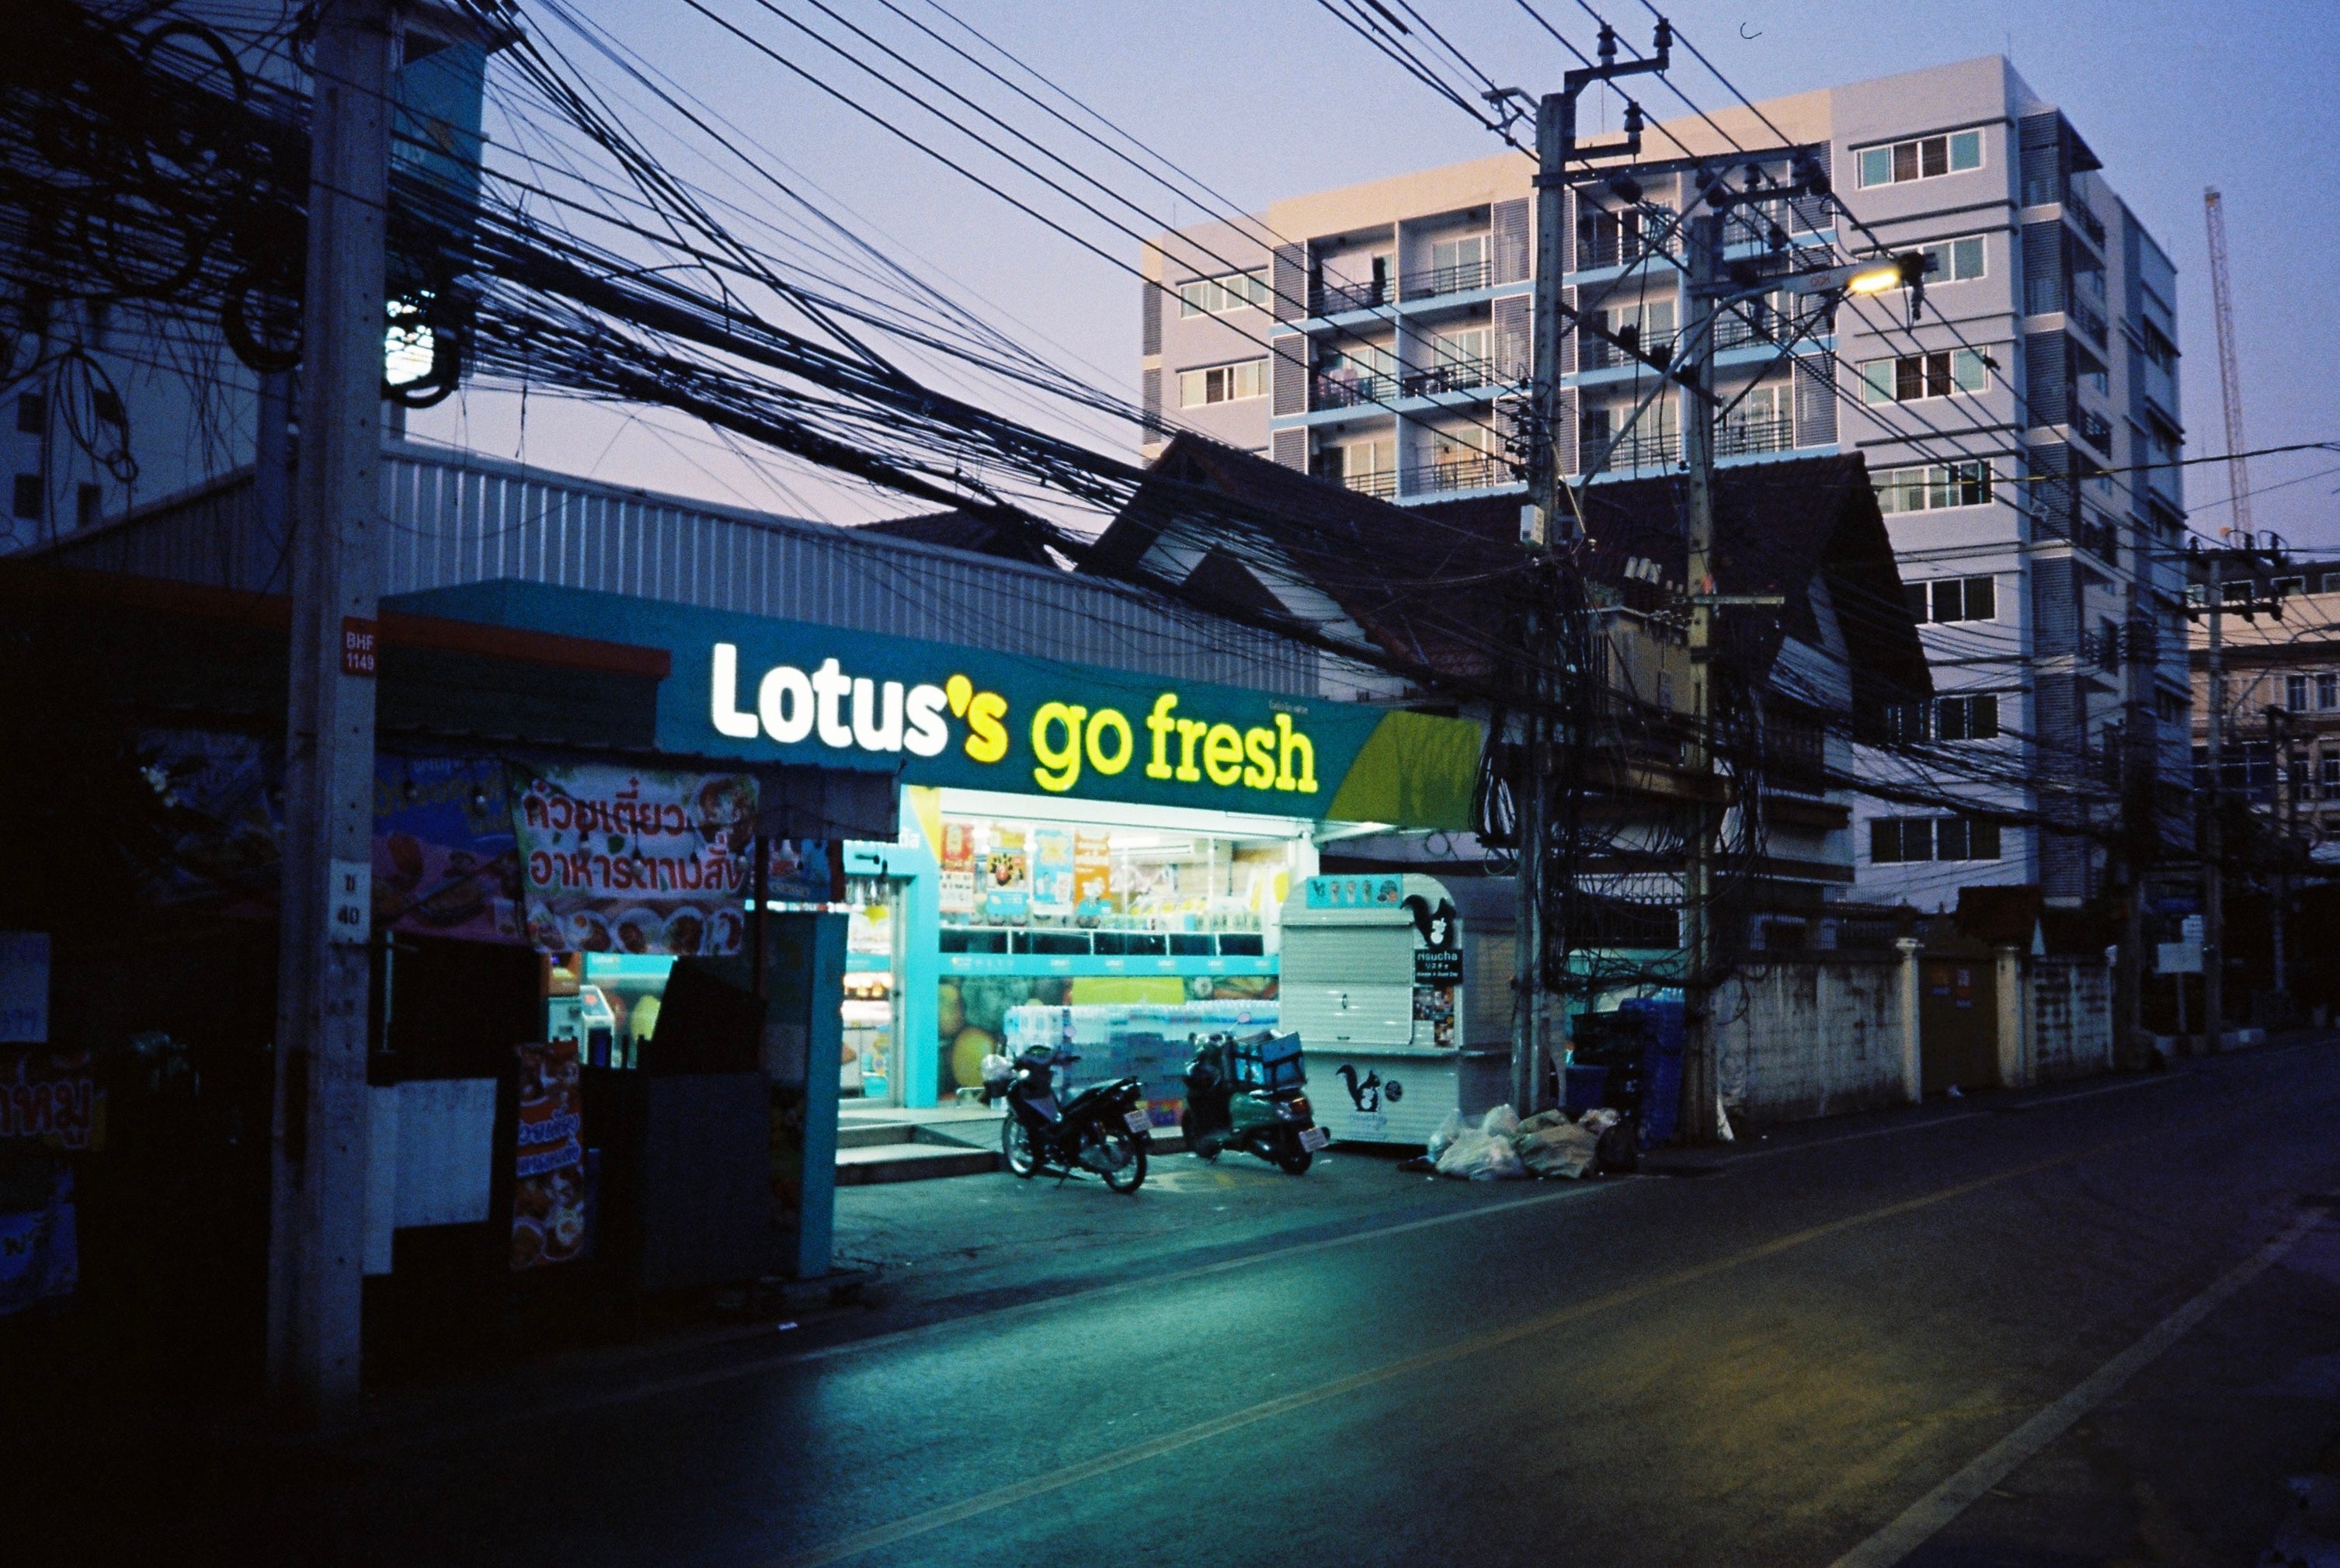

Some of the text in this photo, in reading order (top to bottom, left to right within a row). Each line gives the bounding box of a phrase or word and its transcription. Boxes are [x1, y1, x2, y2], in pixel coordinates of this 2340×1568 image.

[346, 631, 374, 651] BHF
[346, 652, 374, 671] 1149
[711, 642, 1318, 793] Lotus's go fresh
[522, 776, 686, 836] ก๋วยเตี๋ยว
[530, 833, 743, 892] อาหารตามสั่ง
[1417, 951, 1458, 961] risucha
